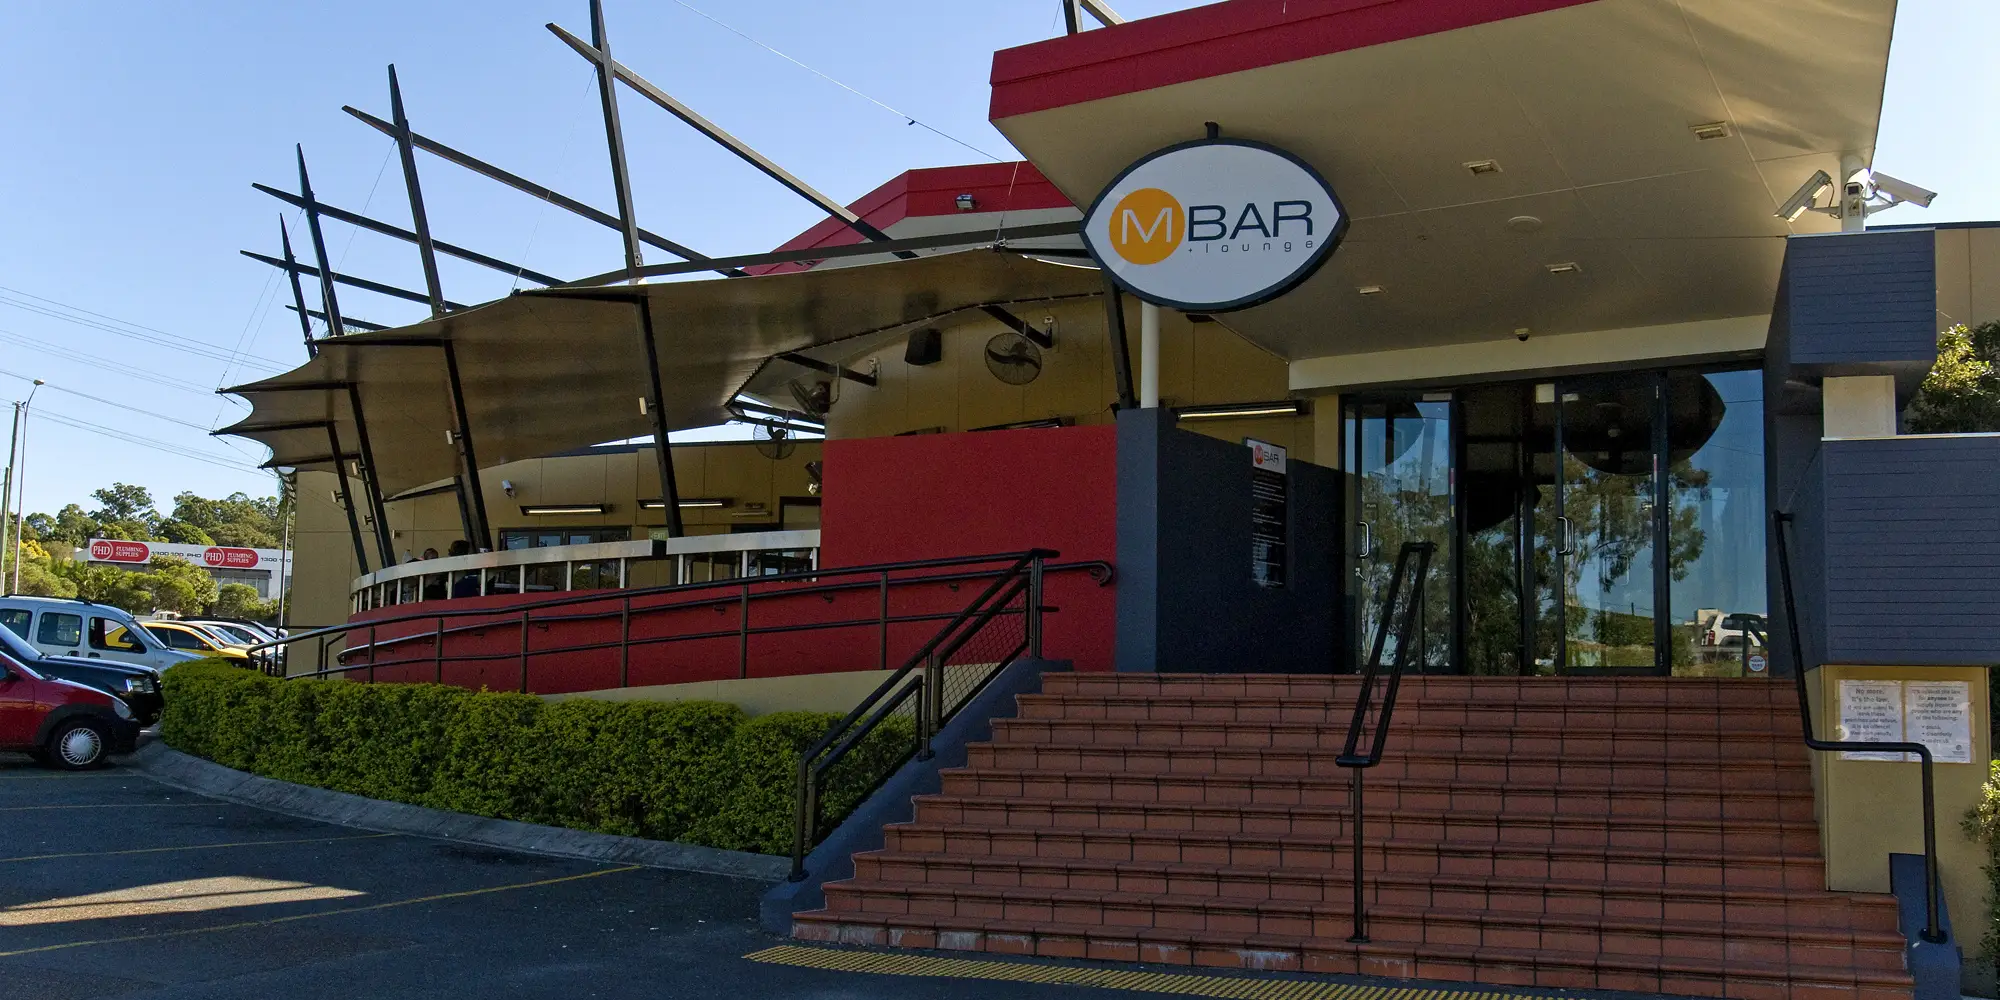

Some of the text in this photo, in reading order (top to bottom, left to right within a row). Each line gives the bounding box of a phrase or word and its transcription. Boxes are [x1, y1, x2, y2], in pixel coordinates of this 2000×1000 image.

[1121, 200, 1313, 245] M BAR
[93, 545, 111, 555] PHD
[116, 545, 144, 553] PLUMBING
[205, 552, 222, 562] PHD
